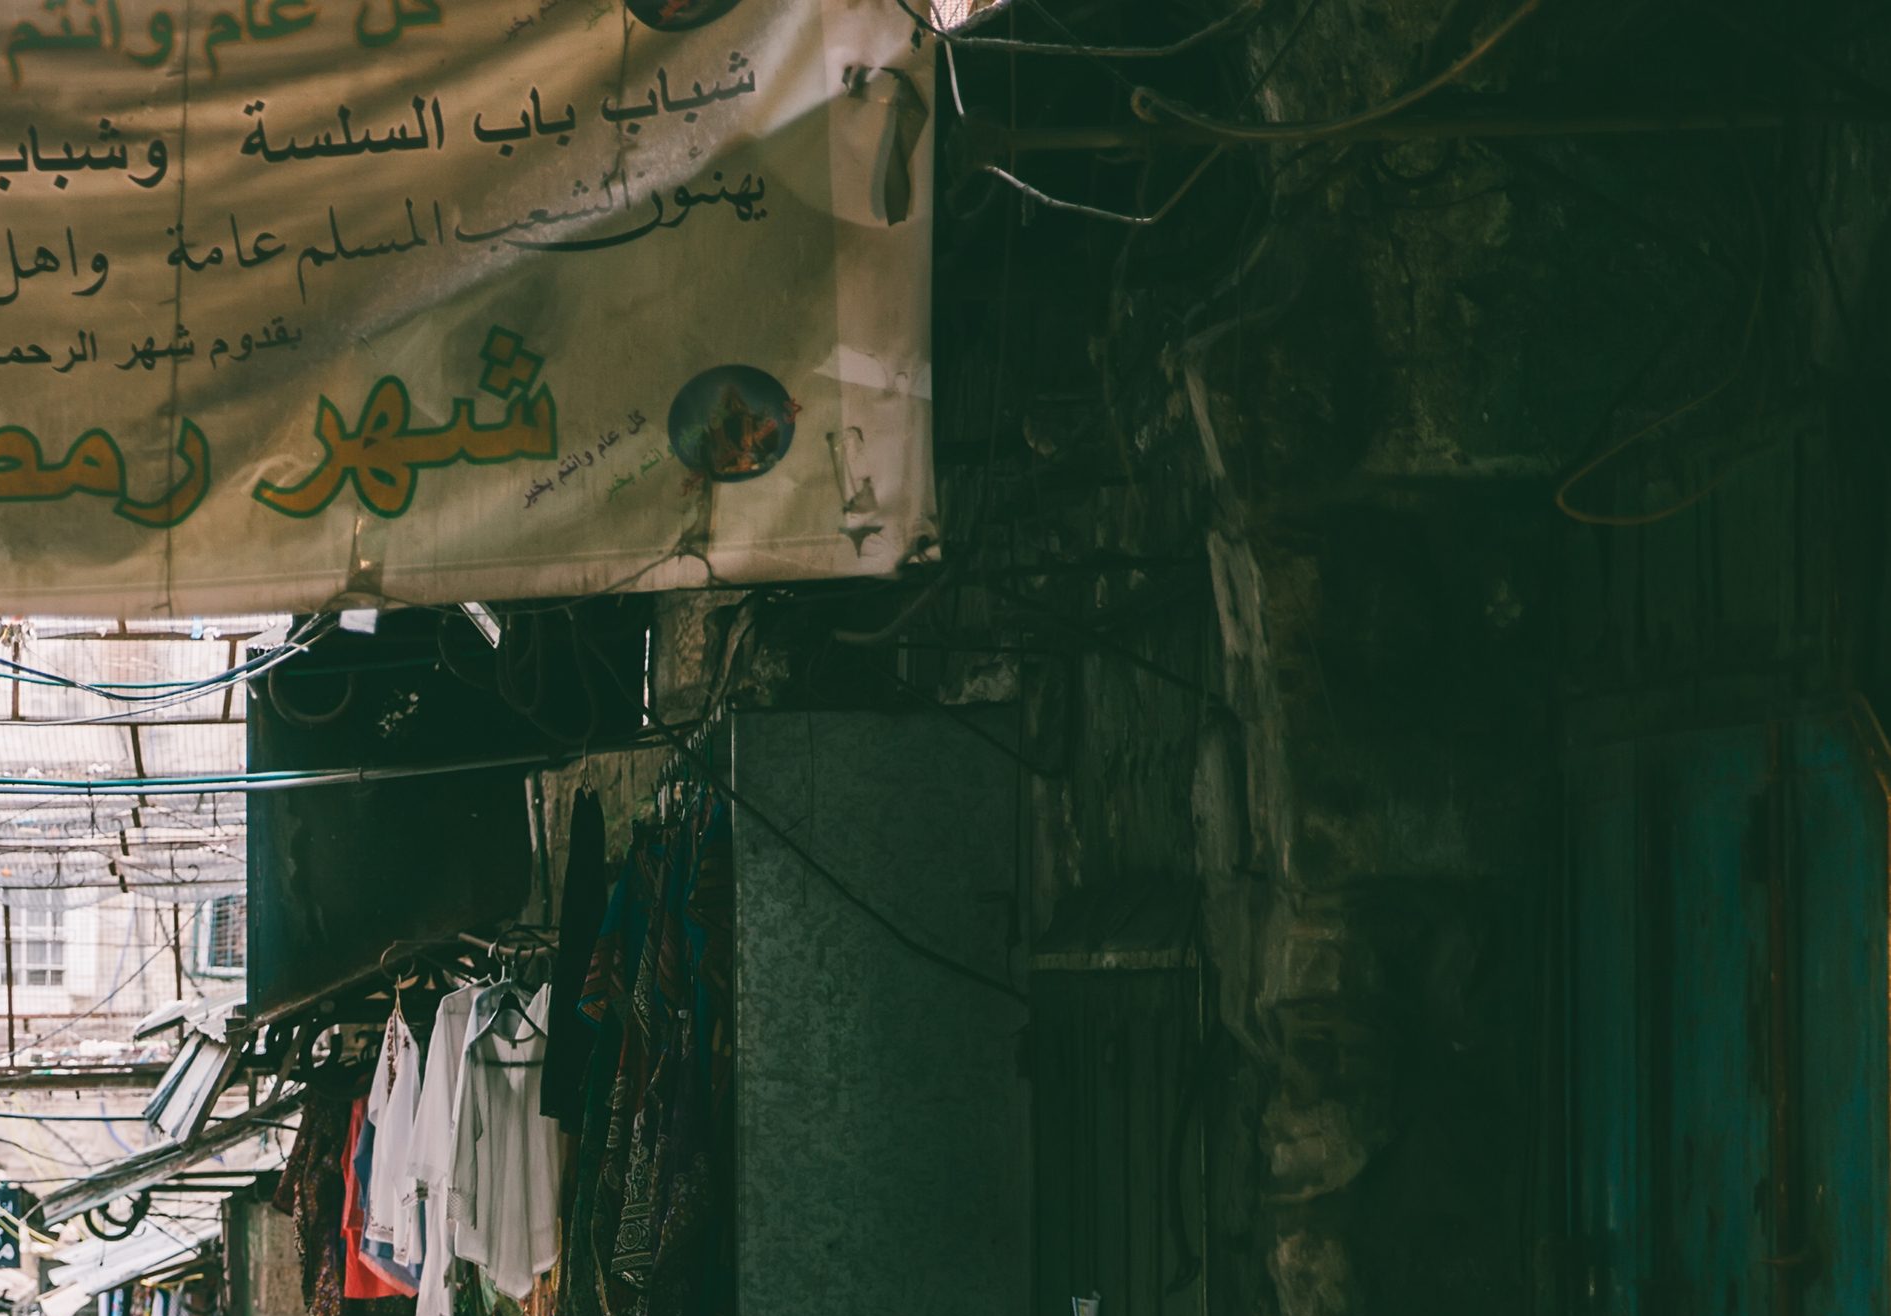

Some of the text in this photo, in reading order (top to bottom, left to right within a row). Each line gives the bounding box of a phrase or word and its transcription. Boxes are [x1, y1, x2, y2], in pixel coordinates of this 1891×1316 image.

[472, 85, 577, 158] باب
[599, 50, 756, 136] شباب
[239, 94, 446, 164] السلسة
[454, 168, 631, 253] الشعب
[165, 212, 287, 272] عامة
[295, 197, 445, 305] المسلم
[113, 322, 196, 371] شهر
[208, 315, 303, 370] بقدوم
[251, 323, 559, 520] شهر
[597, 430, 620, 460] عام
[627, 408, 647, 435] كل
[523, 477, 555, 509] بخير
[557, 450, 595, 486] وانتم
